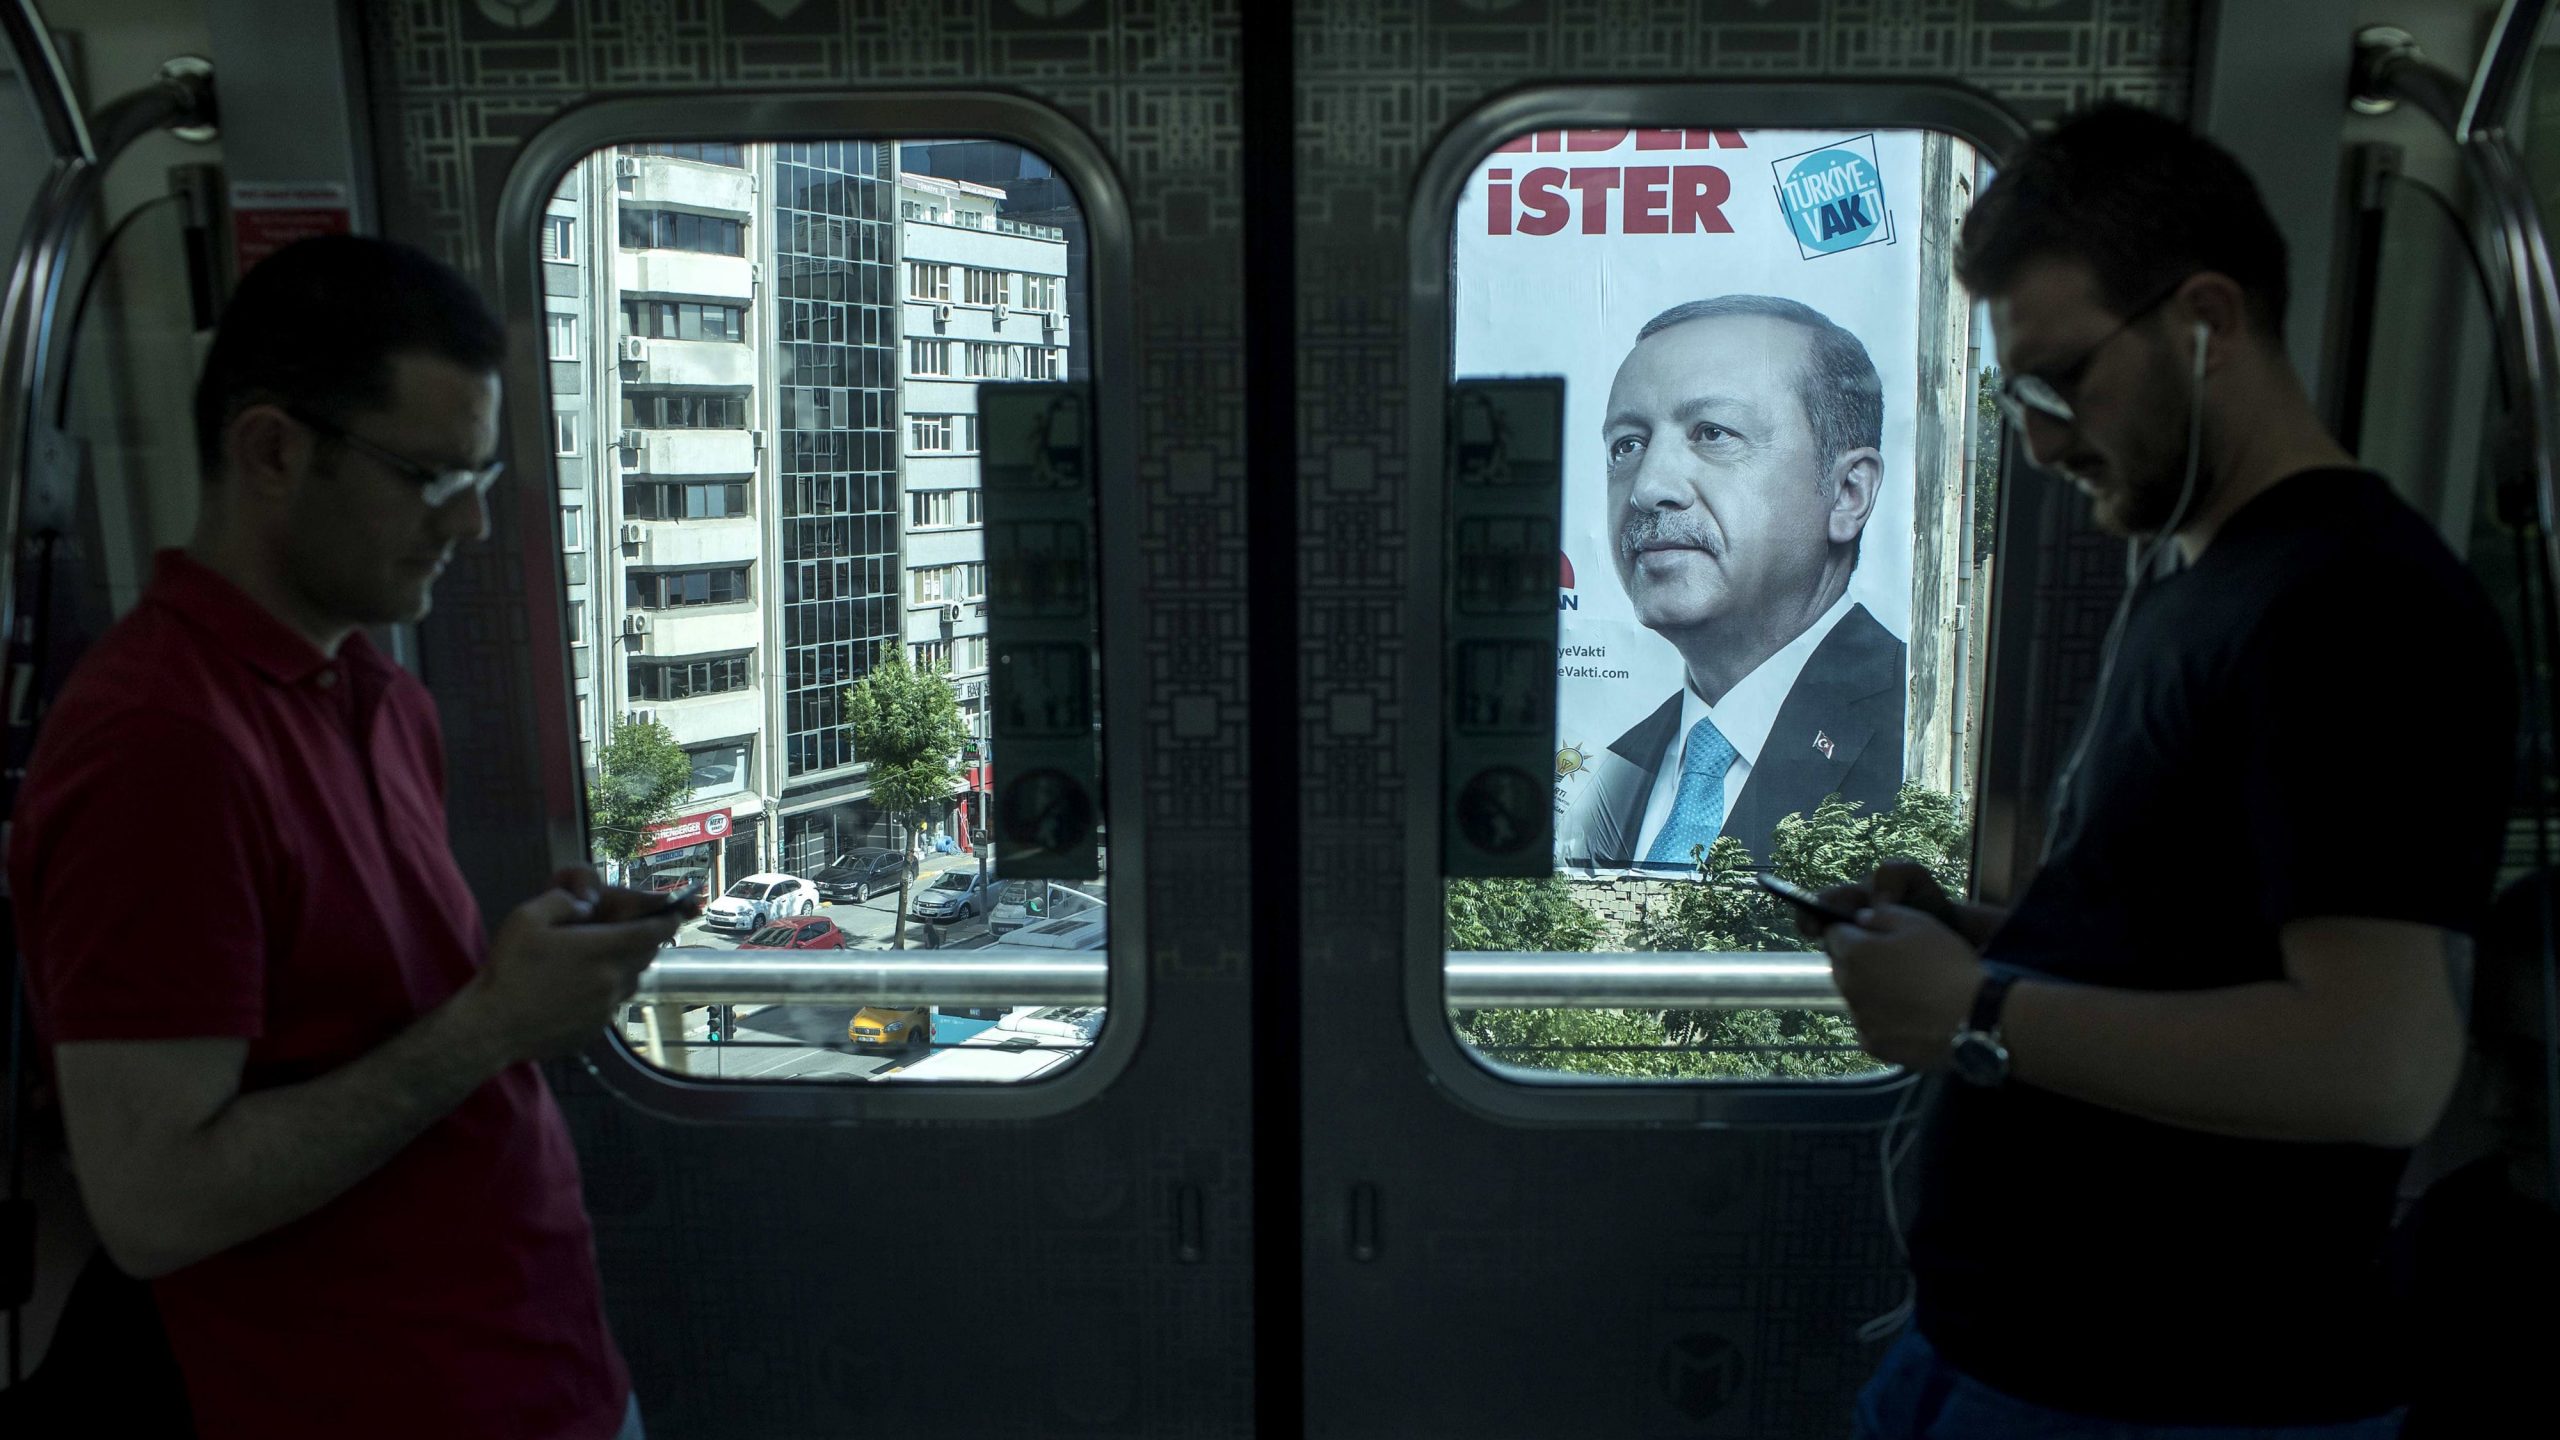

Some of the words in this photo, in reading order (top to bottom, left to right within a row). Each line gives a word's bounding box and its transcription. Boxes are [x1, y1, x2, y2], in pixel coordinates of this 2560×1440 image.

[1783, 160, 1868, 212] TÜRKİYE
[1558, 646, 1606, 658] yeVakti
[1557, 666, 1629, 679] eVakti.com
